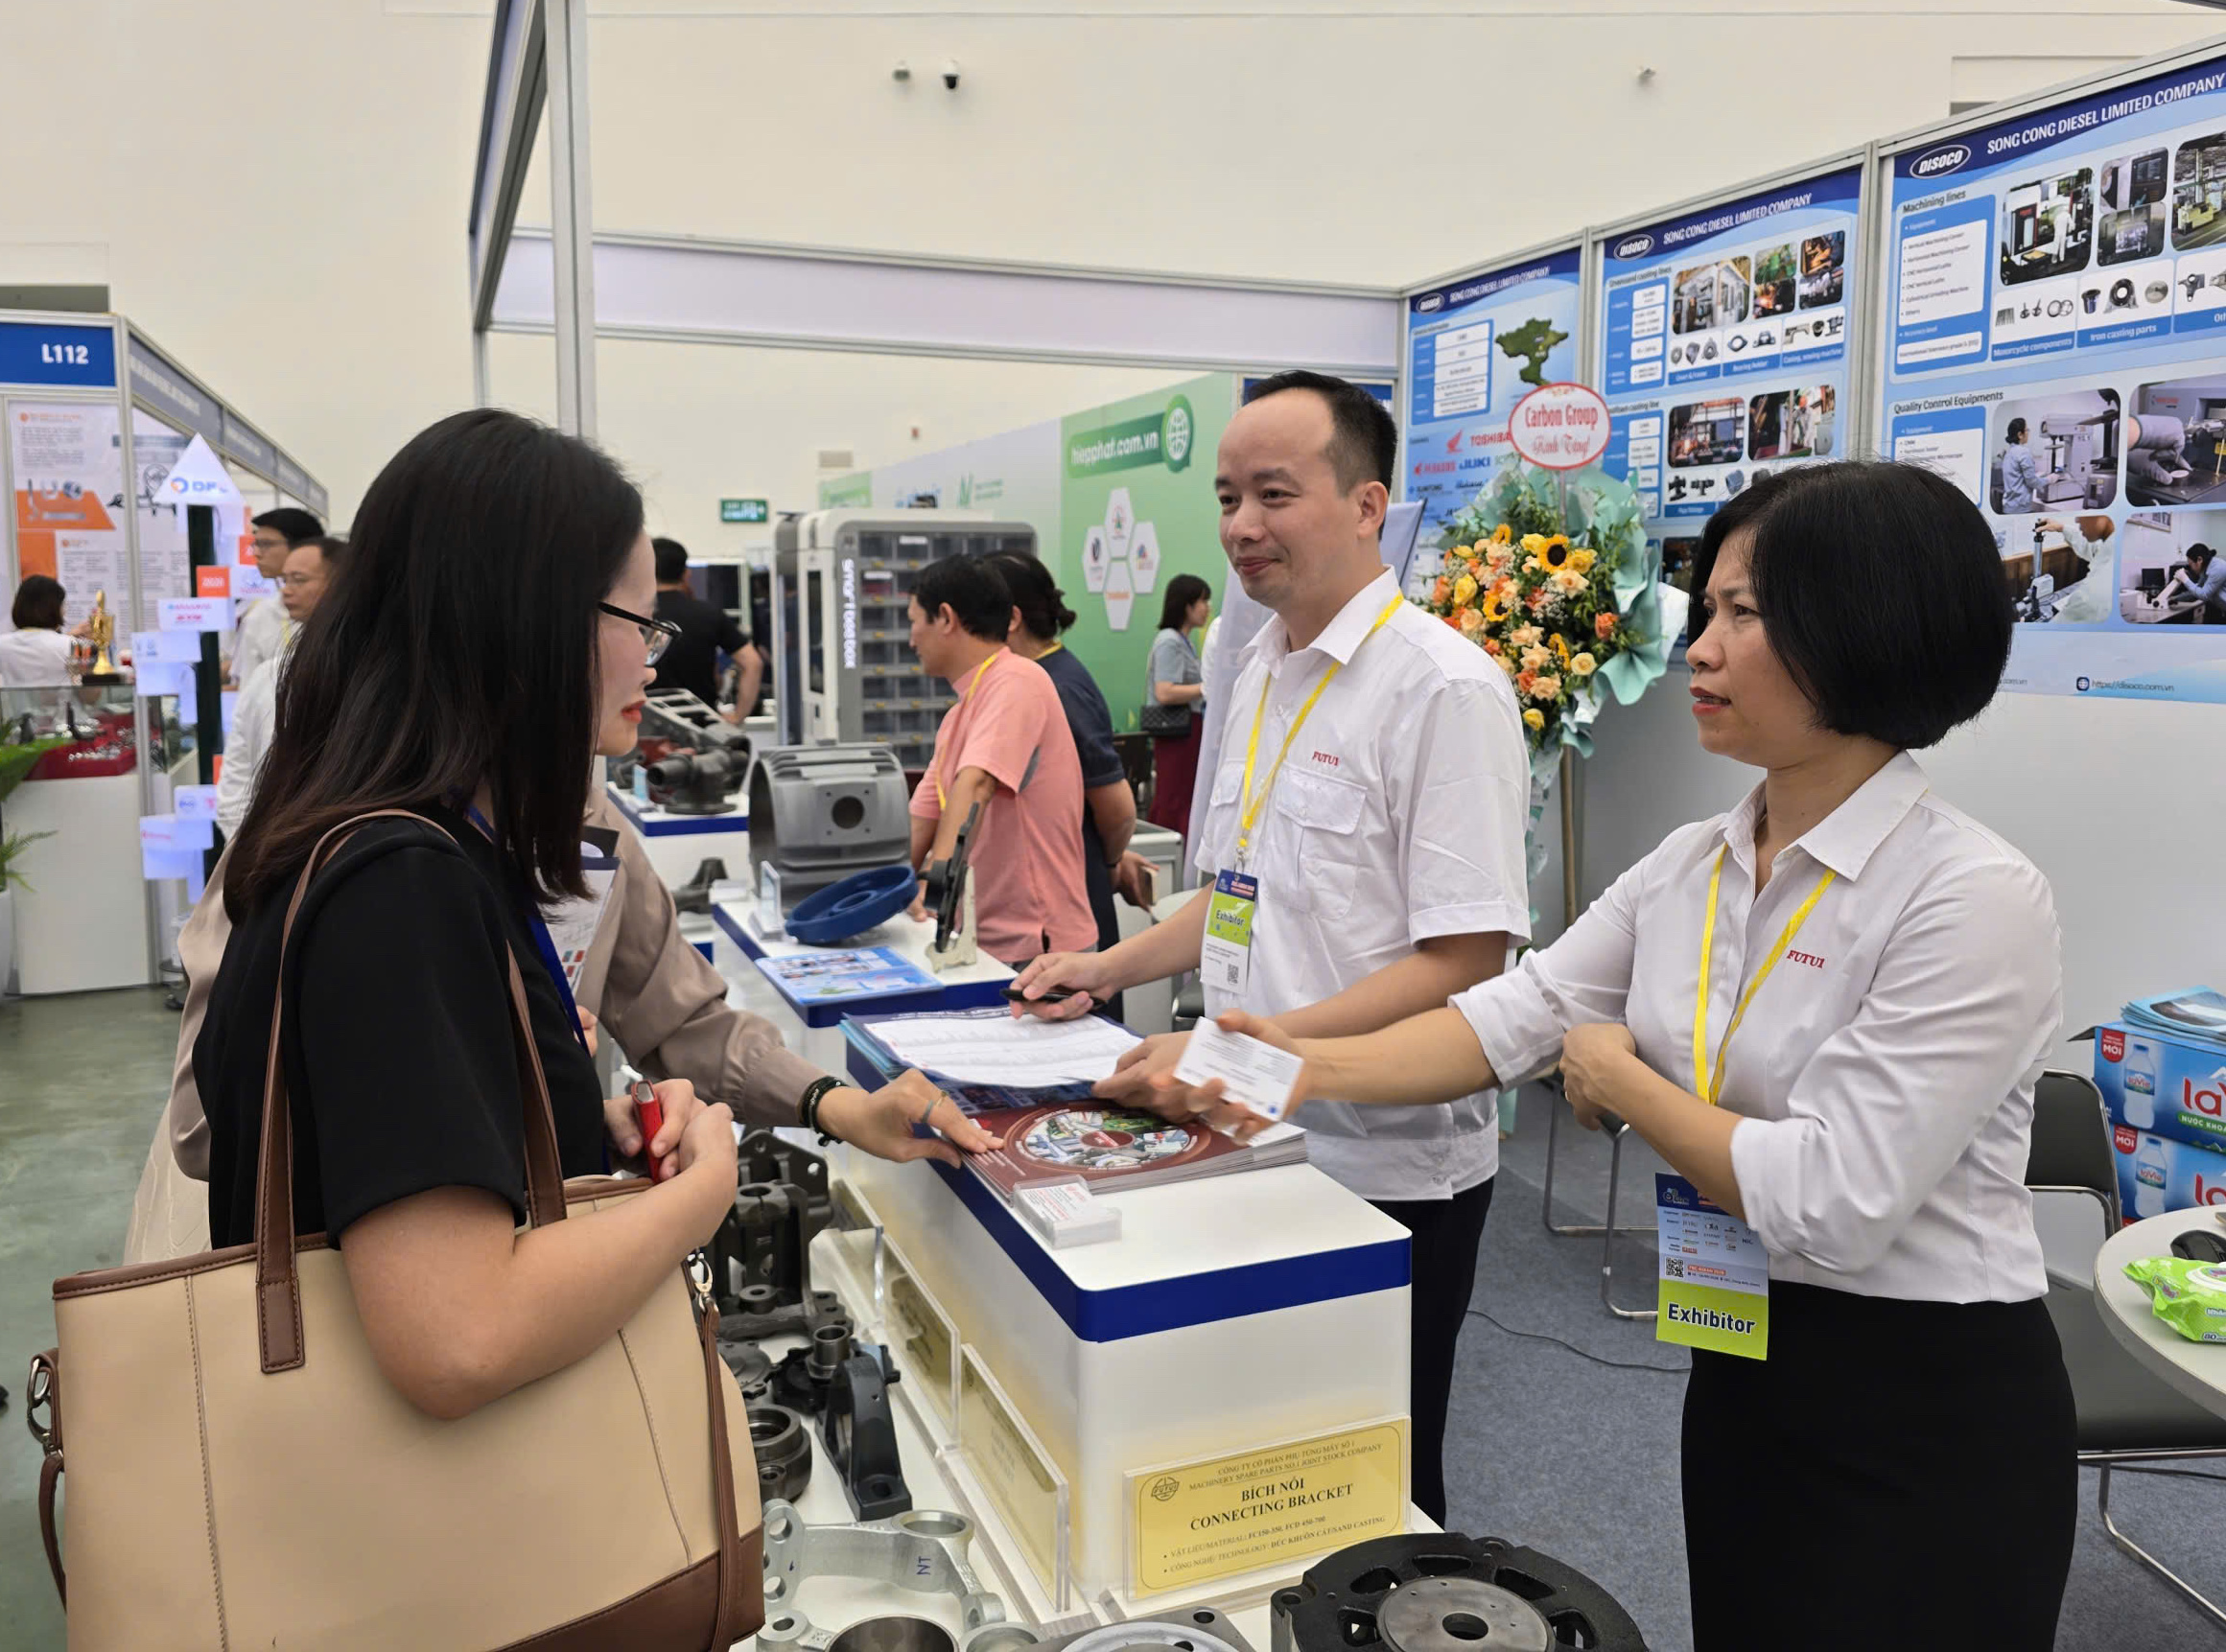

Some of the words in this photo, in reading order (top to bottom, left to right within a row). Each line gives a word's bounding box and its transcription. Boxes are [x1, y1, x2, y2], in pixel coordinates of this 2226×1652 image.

[1987, 134, 2021, 154] SONG
[2022, 123, 2057, 146] CONG
[2058, 110, 2099, 135] DIESEL
[2101, 94, 2152, 121] LIMITED
[2154, 73, 2226, 105] COMPANY
[1918, 150, 1963, 175] DISOCO
[1903, 196, 1945, 213] Machining
[1946, 191, 1966, 202] lines
[1664, 226, 1684, 244] SONG
[1684, 221, 1707, 240] CONG
[1708, 215, 1734, 235] DIESEL
[1735, 206, 1768, 227] LIMITED
[1768, 194, 1813, 216] COMPANY
[2090, 332, 2105, 341] Iron
[2135, 324, 2157, 337] parts
[41, 343, 89, 364] L112
[1894, 401, 1922, 415] Quality
[1923, 397, 1954, 410] Control
[1954, 391, 2003, 407] Equipments
[1525, 404, 1562, 429] Carbon
[1565, 404, 1598, 430] Group
[1215, 910, 1245, 927] Exhibitor
[1667, 1303, 1756, 1336] Exhibitor
[1189, 1477, 1234, 1491] MACHINERY
[1235, 1469, 1259, 1481] SPARE
[1259, 1464, 1283, 1477] PARTS
[1346, 1443, 1384, 1458] COMPANY
[1241, 1483, 1277, 1502] BÍCH
[1190, 1499, 1285, 1531] CONNECTING
[1288, 1483, 1353, 1508] BRACKET
[1353, 1516, 1387, 1531] CASTING
